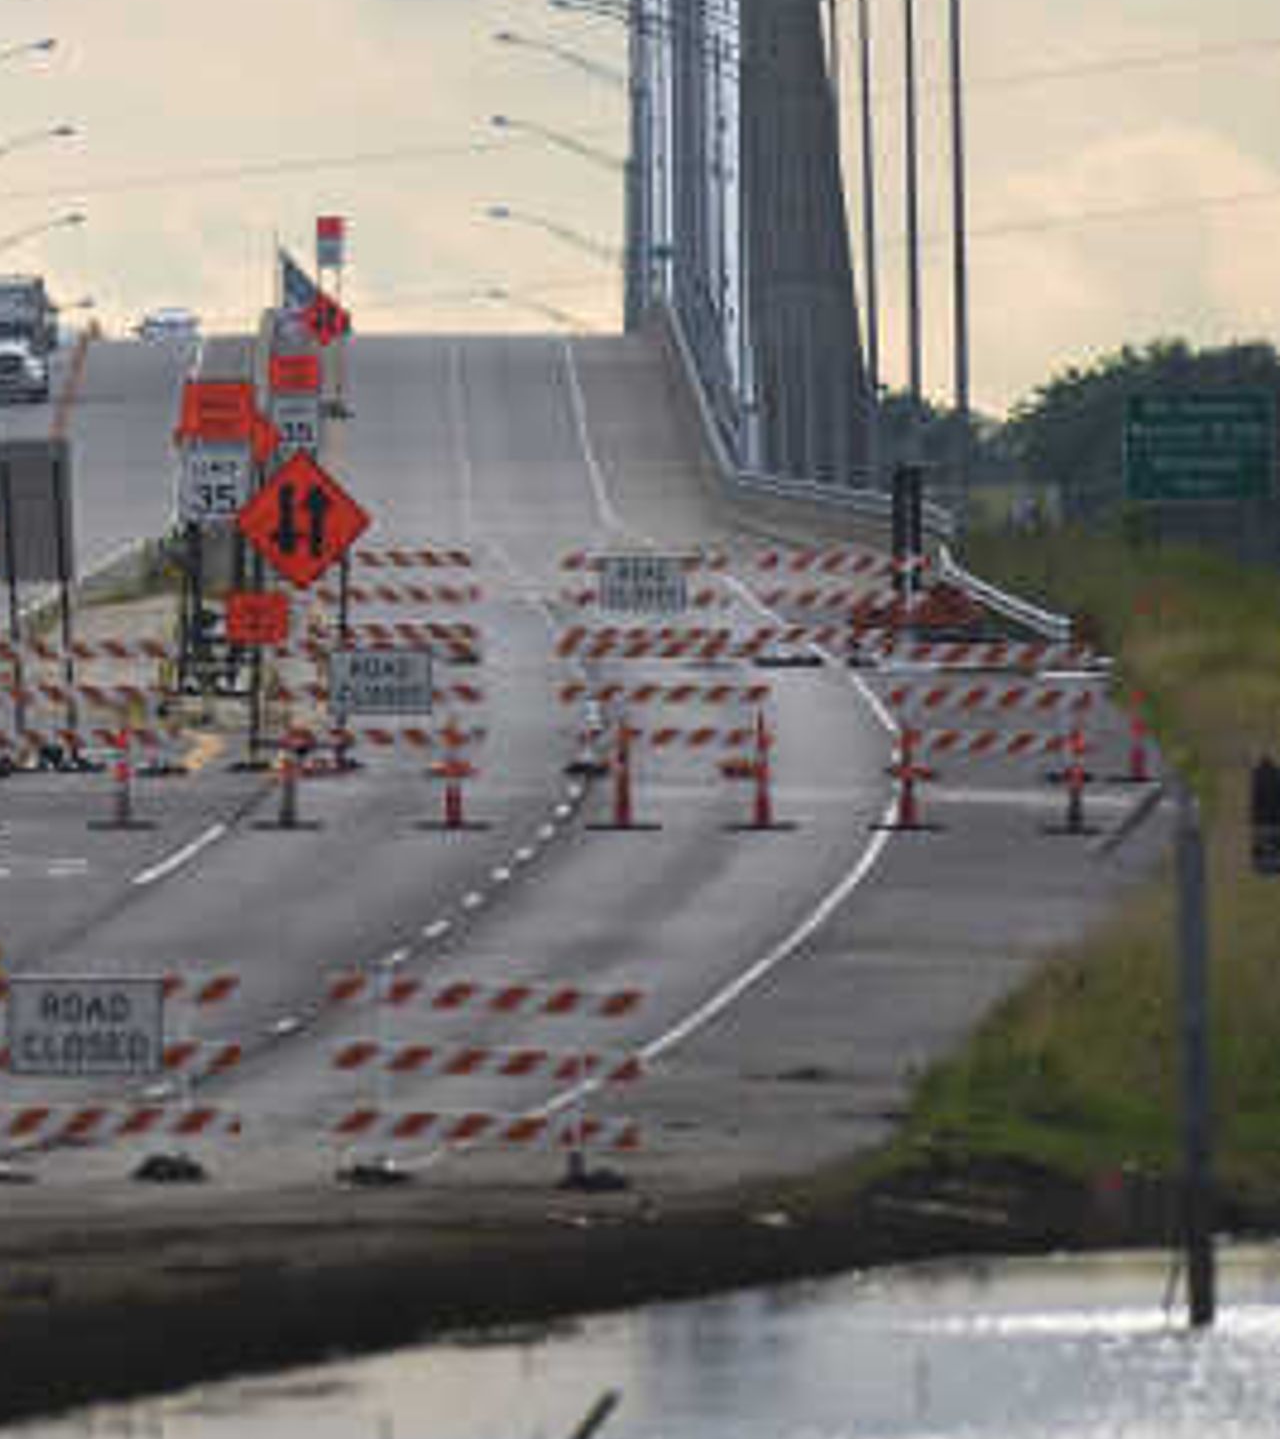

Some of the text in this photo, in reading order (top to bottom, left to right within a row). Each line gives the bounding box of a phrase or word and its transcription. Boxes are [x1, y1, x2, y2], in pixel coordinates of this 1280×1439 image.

[195, 484, 236, 513] 35
[41, 993, 130, 1023] ROAD
[23, 1031, 151, 1062] CLOSED
